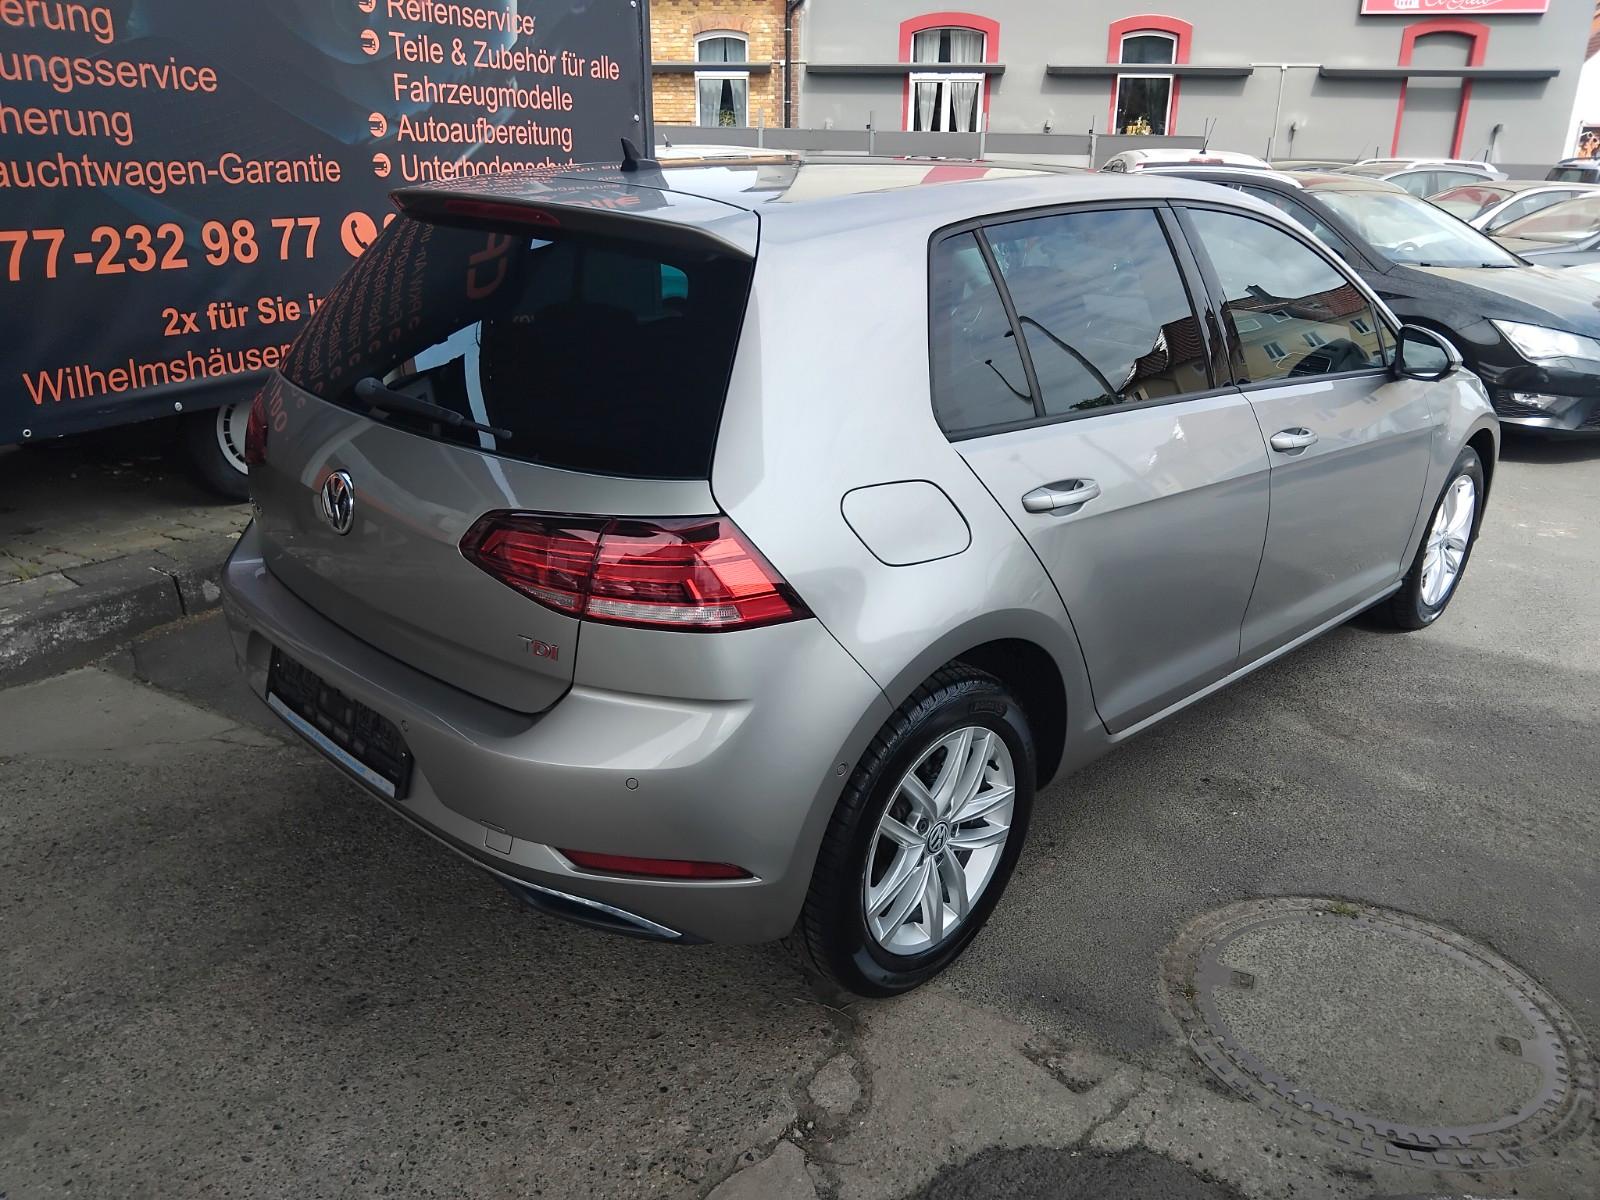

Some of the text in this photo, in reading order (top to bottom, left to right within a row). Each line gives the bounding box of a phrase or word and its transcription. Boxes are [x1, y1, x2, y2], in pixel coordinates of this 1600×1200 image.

[0, 0, 114, 44] erung
[387, 0, 535, 36] Reifenservice
[0, 52, 218, 93] ungsservice
[389, 31, 620, 81] Teile & Zubehör für alle
[393, 72, 573, 113] Fahrzeugmodelle
[397, 114, 573, 153] Autoaufbereitung
[0, 216, 321, 282] 77-232 98 77
[161, 307, 200, 337] 2x
[207, 302, 249, 331] für
[257, 295, 301, 325] Sie
[518, 633, 559, 661] TDI
